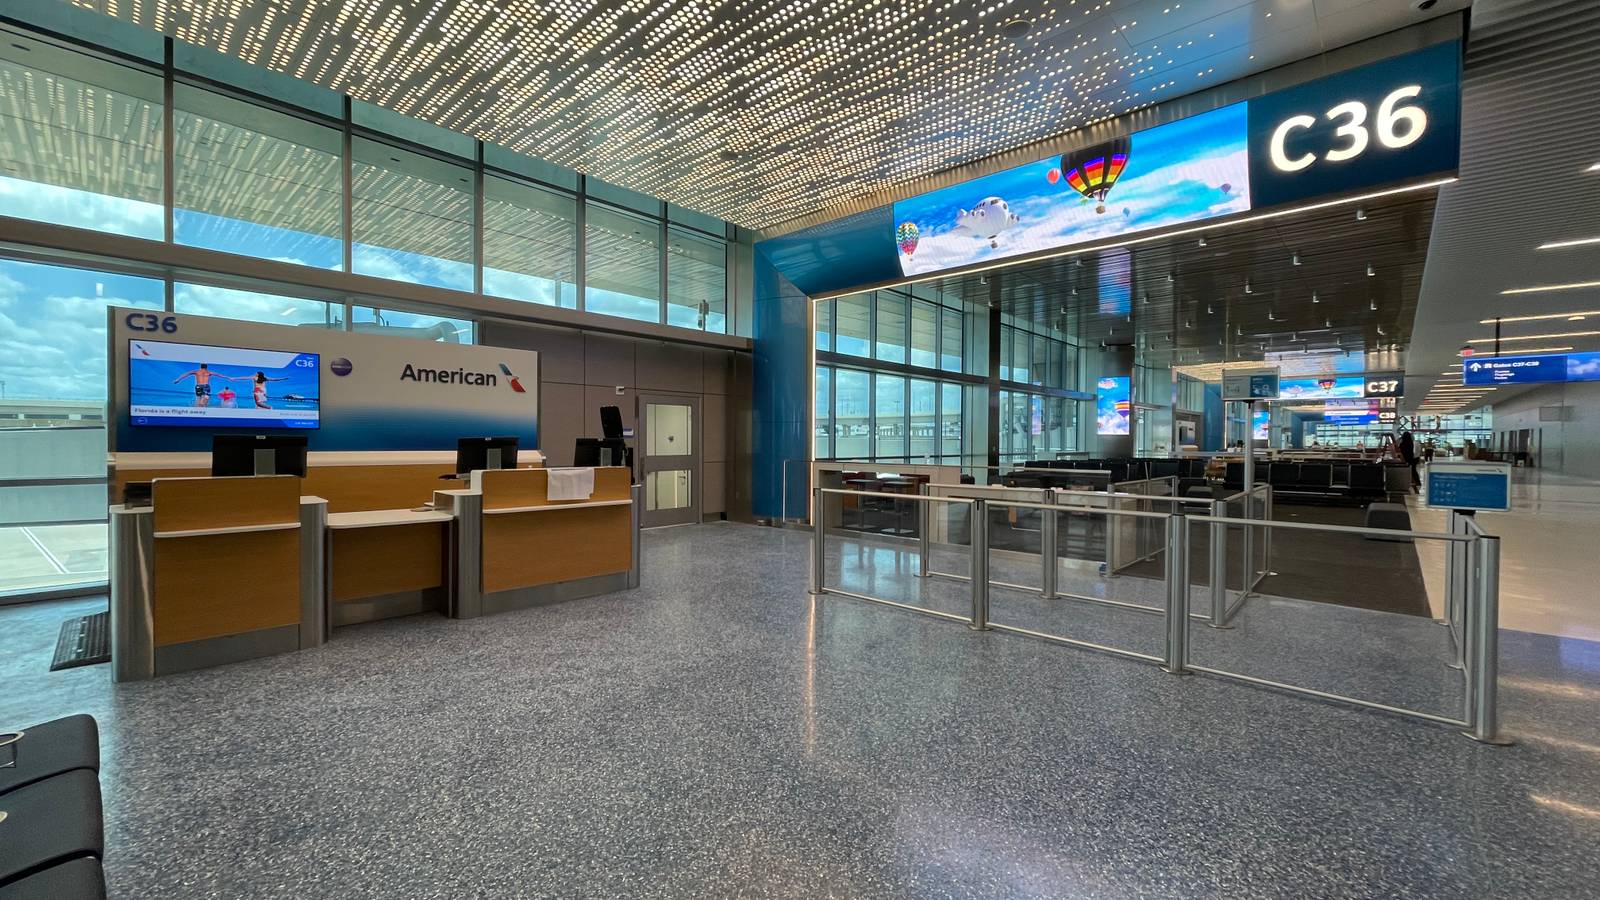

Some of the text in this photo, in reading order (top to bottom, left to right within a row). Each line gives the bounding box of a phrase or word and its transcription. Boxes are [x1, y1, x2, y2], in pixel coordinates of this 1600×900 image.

[1269, 85, 1428, 172] C36
[126, 313, 177, 333] C36
[295, 360, 314, 368] C36
[400, 364, 497, 386] American
[1367, 380, 1399, 393] C37
